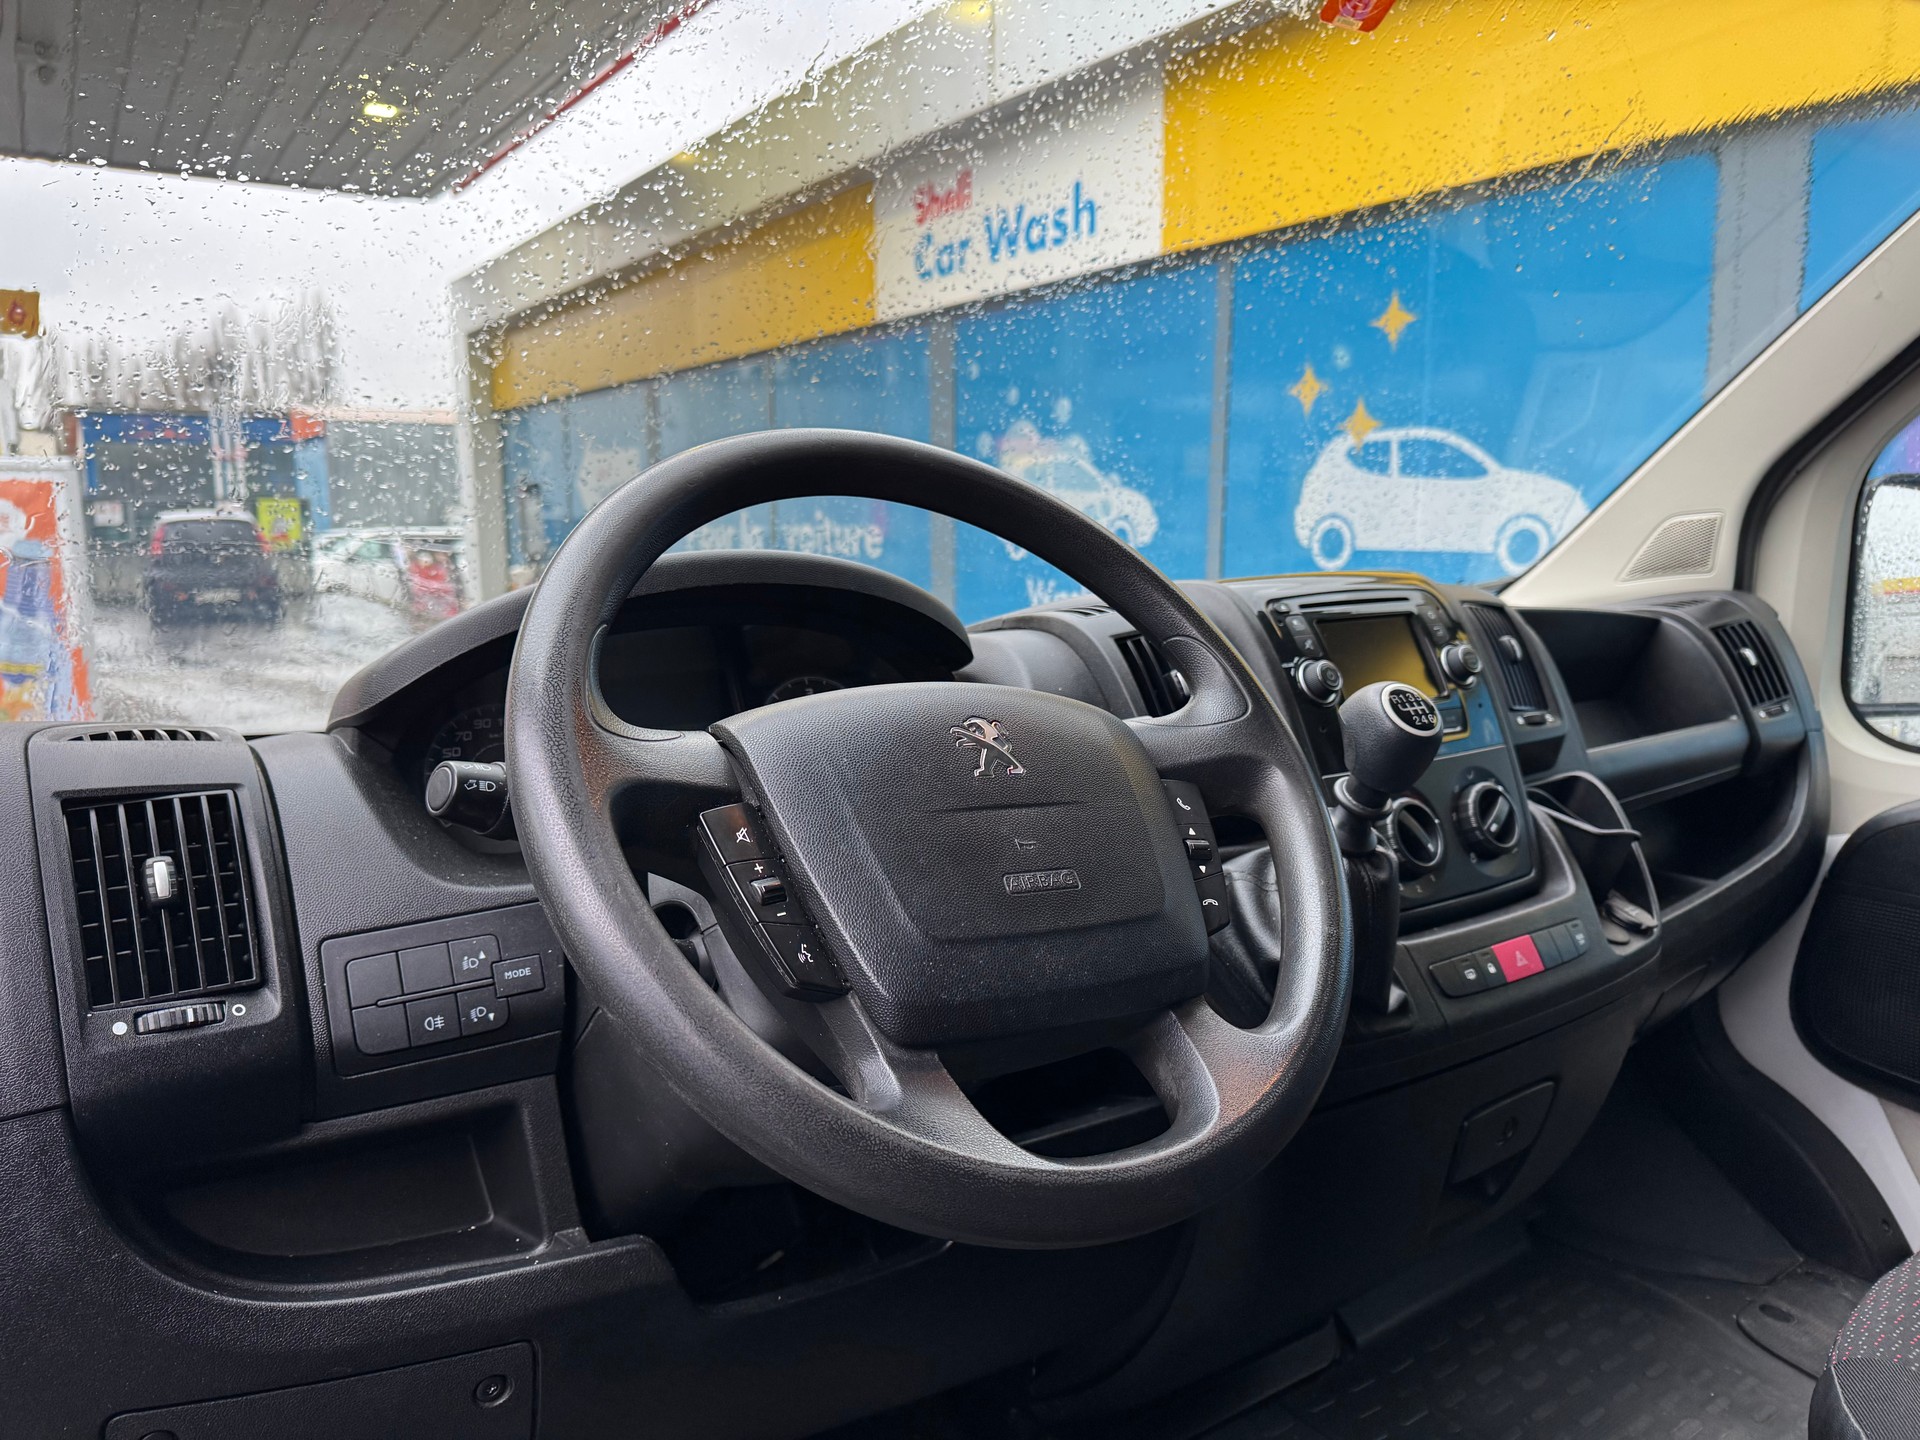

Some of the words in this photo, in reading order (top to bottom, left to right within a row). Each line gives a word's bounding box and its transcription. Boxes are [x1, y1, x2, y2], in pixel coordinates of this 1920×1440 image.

[914, 231, 970, 281] Car
[984, 180, 1097, 263] Wash
[473, 718, 491, 729] 90
[455, 731, 472, 742] 70
[441, 746, 462, 758] 50
[1009, 871, 1073, 891] AIRBAG
[504, 966, 532, 979] MODE
